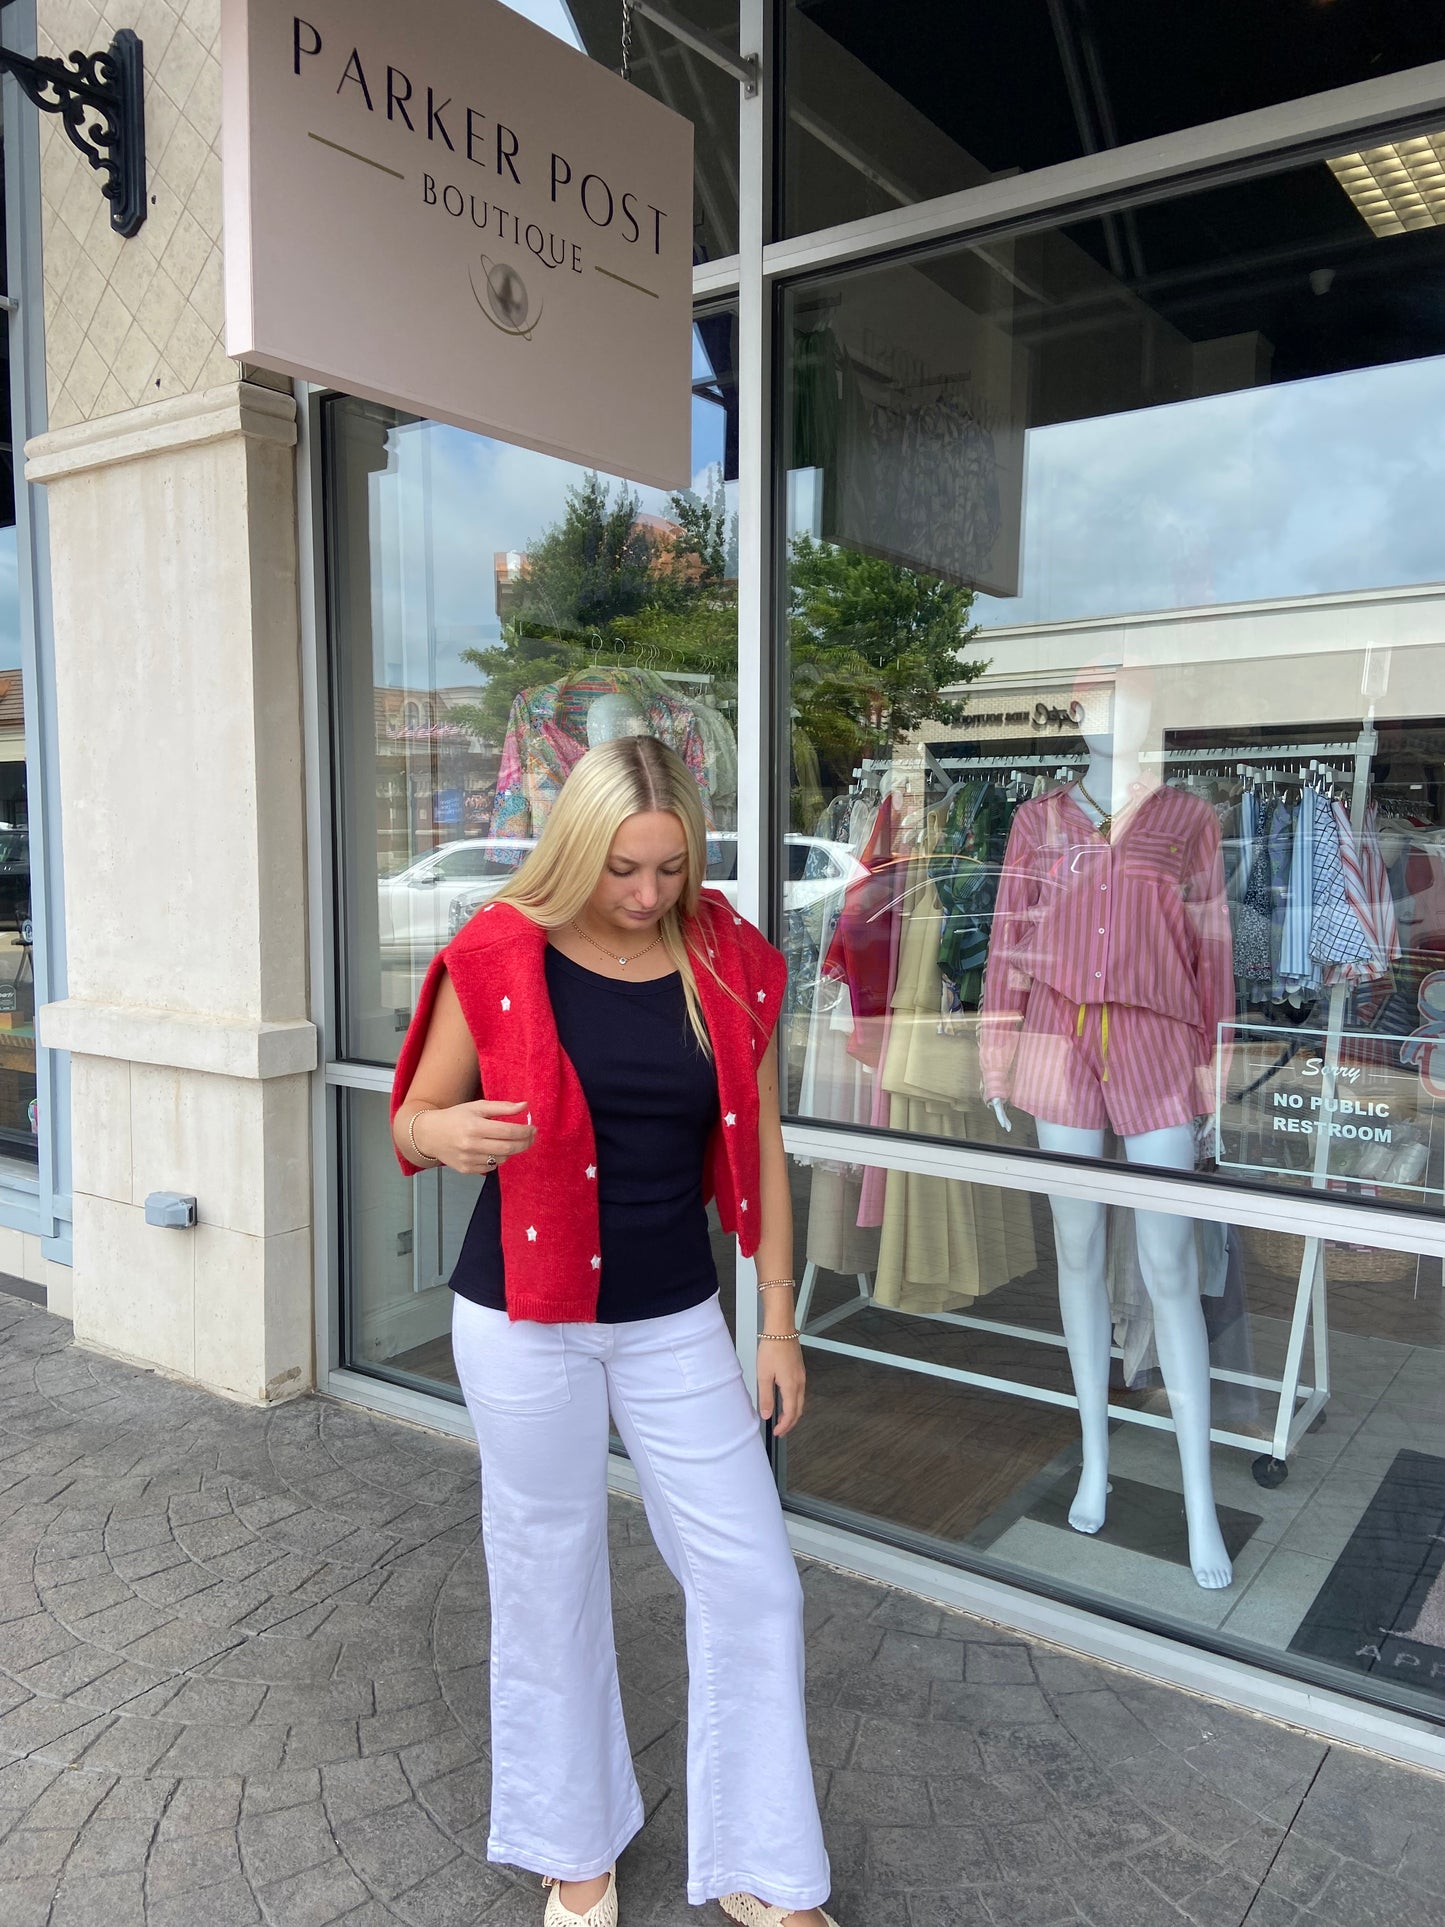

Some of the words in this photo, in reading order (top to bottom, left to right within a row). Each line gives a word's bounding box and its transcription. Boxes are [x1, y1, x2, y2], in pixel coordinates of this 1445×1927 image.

[293, 16, 522, 185] PARKER
[550, 152, 668, 255] POST
[423, 173, 583, 273] BOUTIQUE
[1301, 1057, 1361, 1083] Sorry
[1273, 1092, 1303, 1108] NO
[1310, 1096, 1390, 1117] PUBLIC
[1273, 1116, 1392, 1143] RESTROOM
